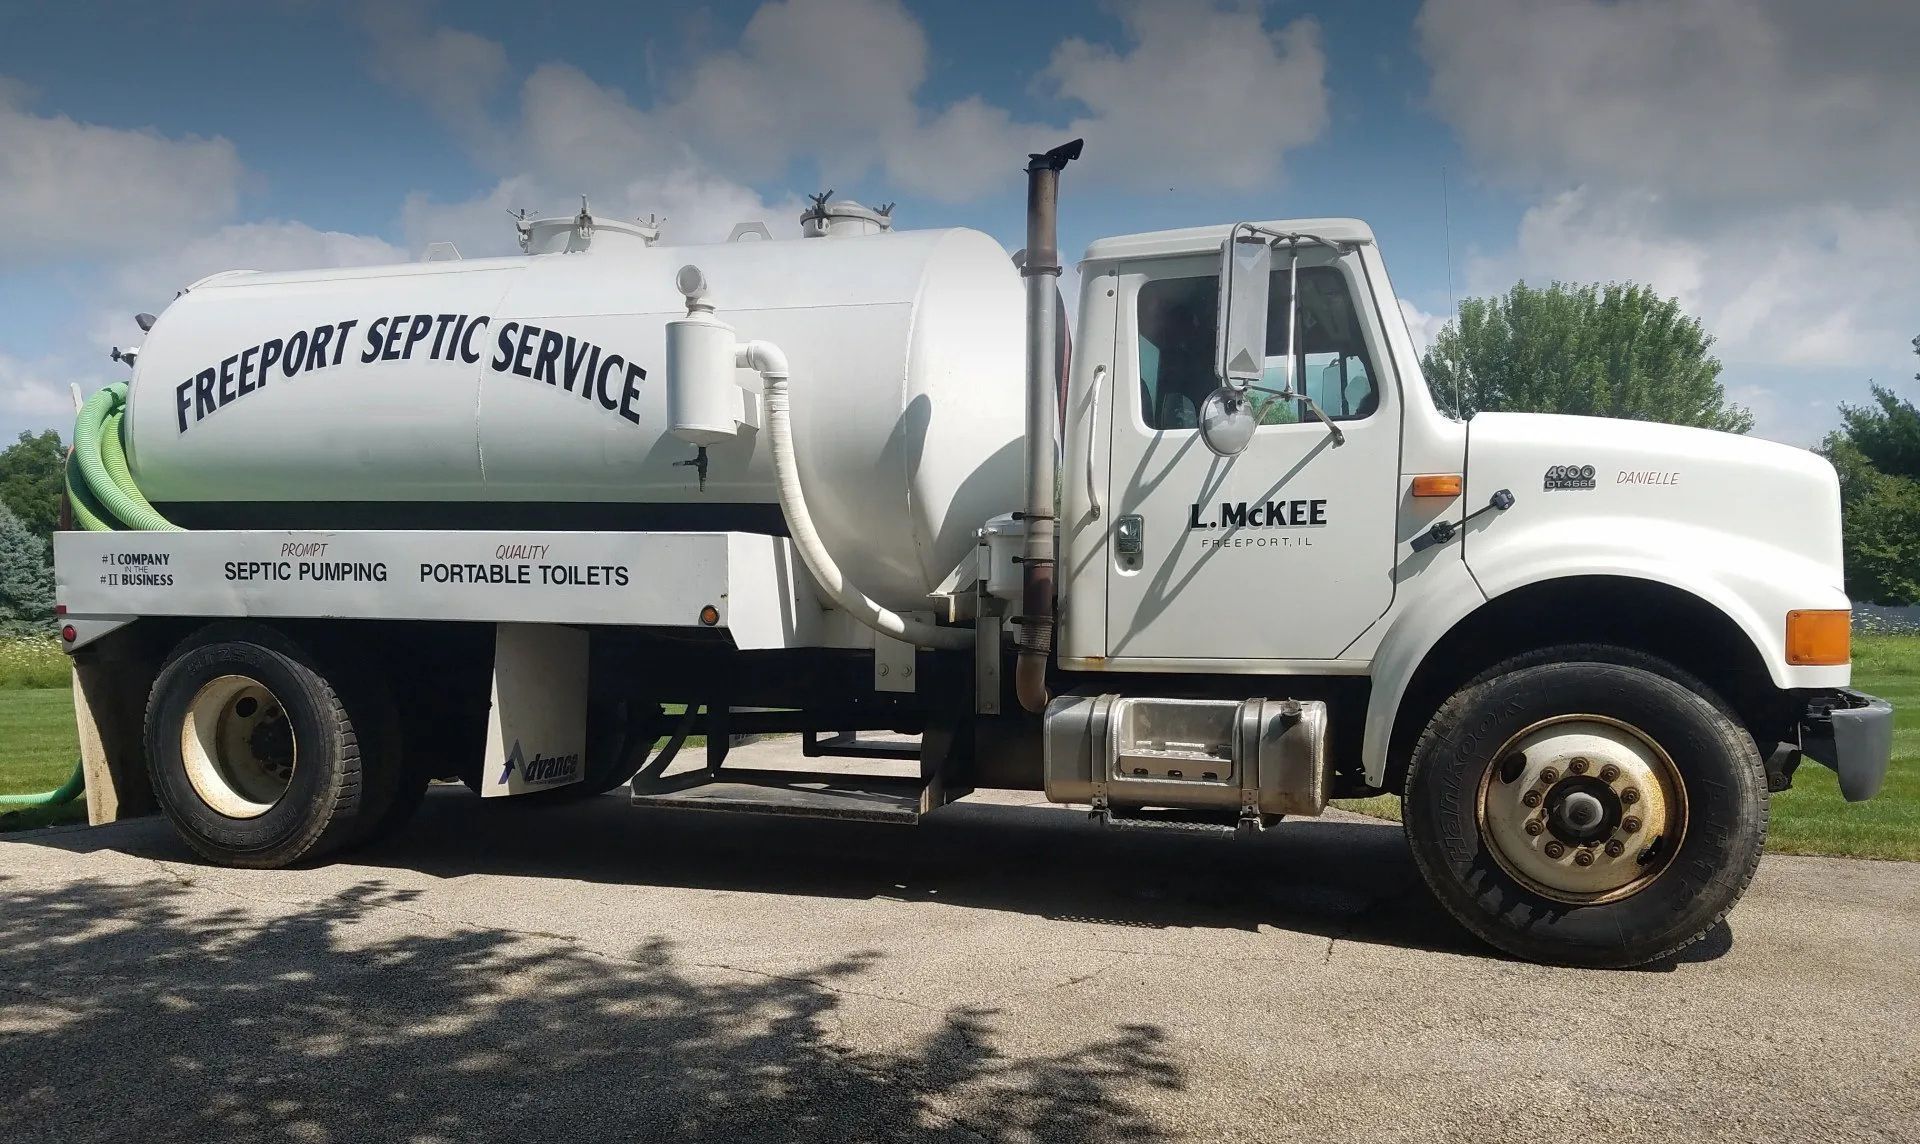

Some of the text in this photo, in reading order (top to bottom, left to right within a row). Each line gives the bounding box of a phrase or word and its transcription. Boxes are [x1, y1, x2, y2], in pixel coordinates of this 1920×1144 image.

[176, 313, 647, 434] FREEPORT SEPTIC SERVICE
[1546, 465, 1596, 480] 4900
[1616, 471, 1681, 485] DANIELLE
[1546, 480, 1563, 488] DT
[1201, 537, 1313, 548] FREEPORT, IL
[280, 543, 329, 557] PROMPT
[495, 544, 550, 560] QUALITY
[117, 553, 170, 566] COMPANY
[124, 565, 149, 573] IN THE
[224, 561, 387, 582] SEPTIC PUMPING
[420, 563, 630, 586] PORTABLE TOILETS
[121, 574, 174, 586] BUSINESS
